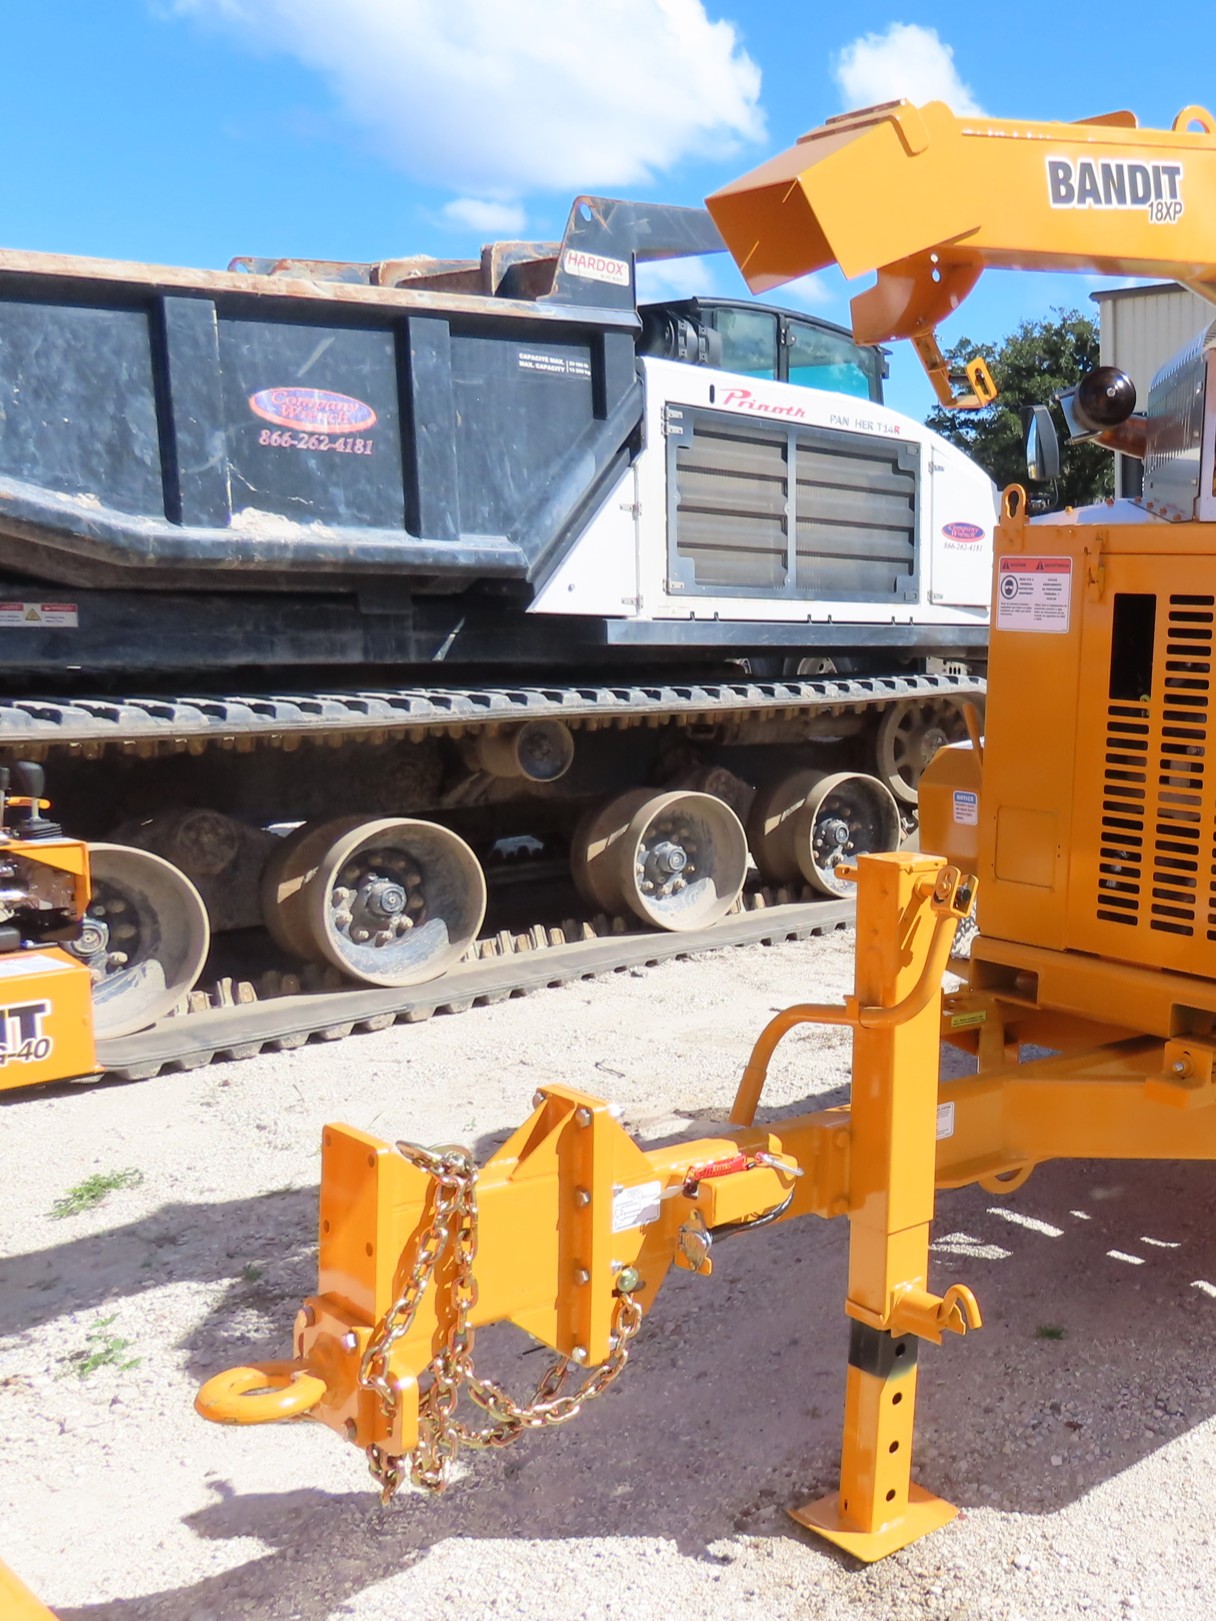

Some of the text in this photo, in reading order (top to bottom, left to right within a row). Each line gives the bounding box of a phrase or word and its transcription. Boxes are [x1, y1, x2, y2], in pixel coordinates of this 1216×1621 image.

[1047, 160, 1181, 205] BANDIT
[1148, 201, 1182, 222] 18XP
[567, 252, 624, 276] HARDOX
[535, 363, 565, 373] CAPACITY
[271, 391, 359, 414] Company
[720, 388, 806, 418] Prinoth
[877, 422, 900, 435] T14R
[259, 429, 373, 455] 866-262-4181
